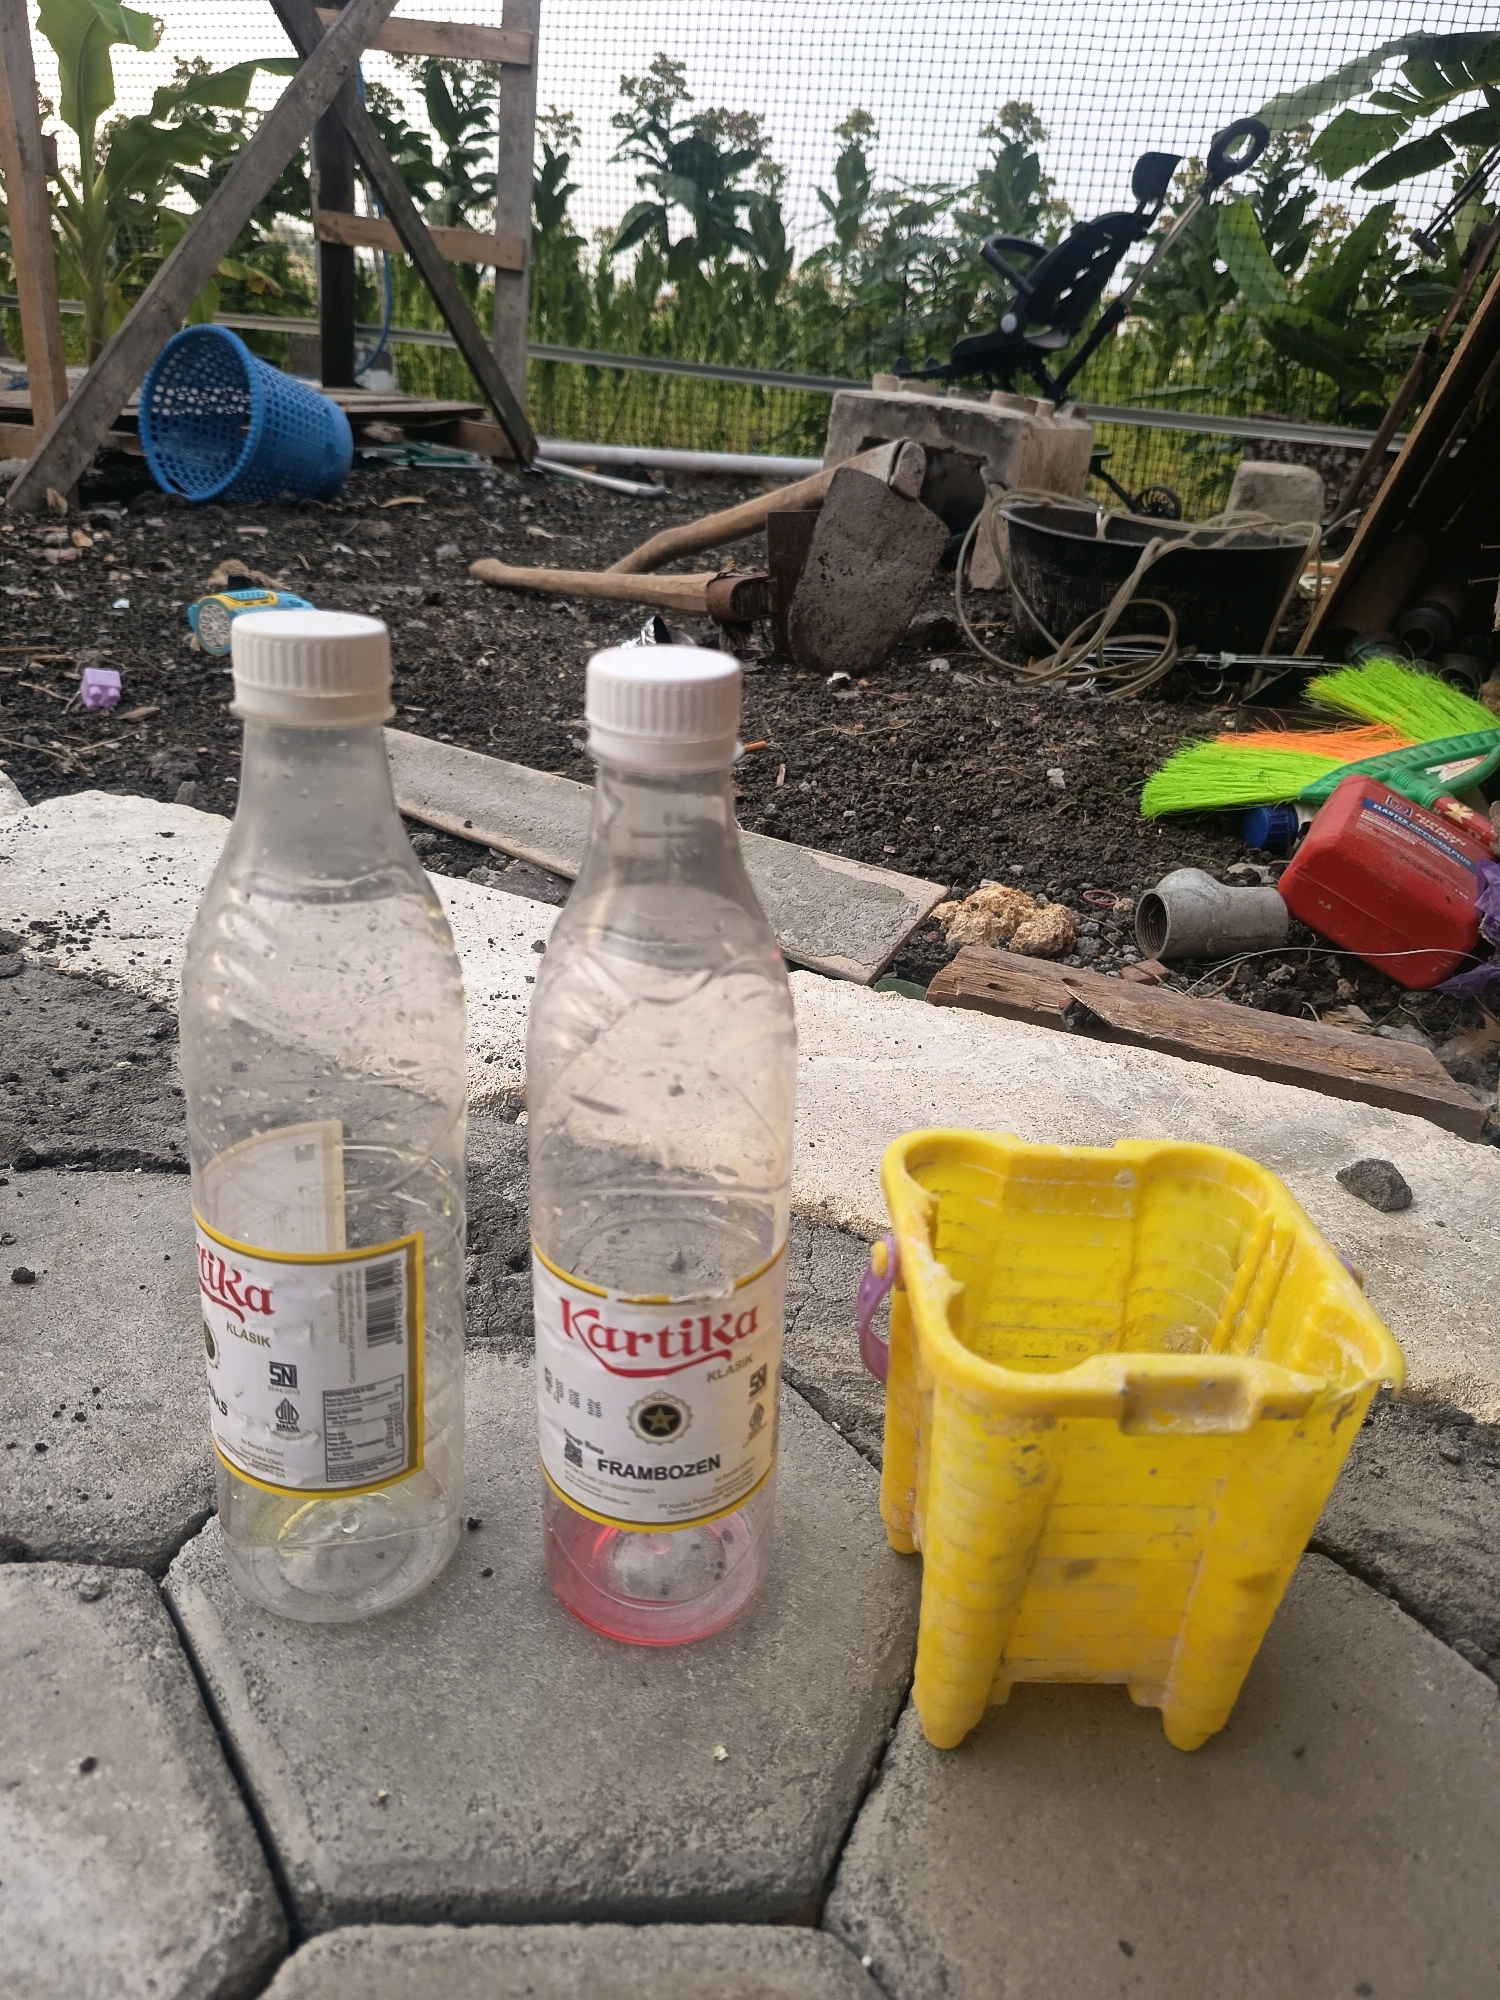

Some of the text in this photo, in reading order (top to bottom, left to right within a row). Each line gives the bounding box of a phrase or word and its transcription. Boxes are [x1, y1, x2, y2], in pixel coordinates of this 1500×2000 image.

[1372, 803, 1408, 825] ELASTEX
[1450, 850, 1471, 865] PLUS
[1415, 812, 1466, 846] NIPPON
[1417, 819, 1457, 844] PAINT
[226, 1321, 271, 1348] KLASIK
[560, 1297, 759, 1379] Kartika
[269, 1361, 297, 1388] SNI
[706, 1352, 753, 1382] KLASIK
[597, 1453, 721, 1481] FRAMBOZEN
